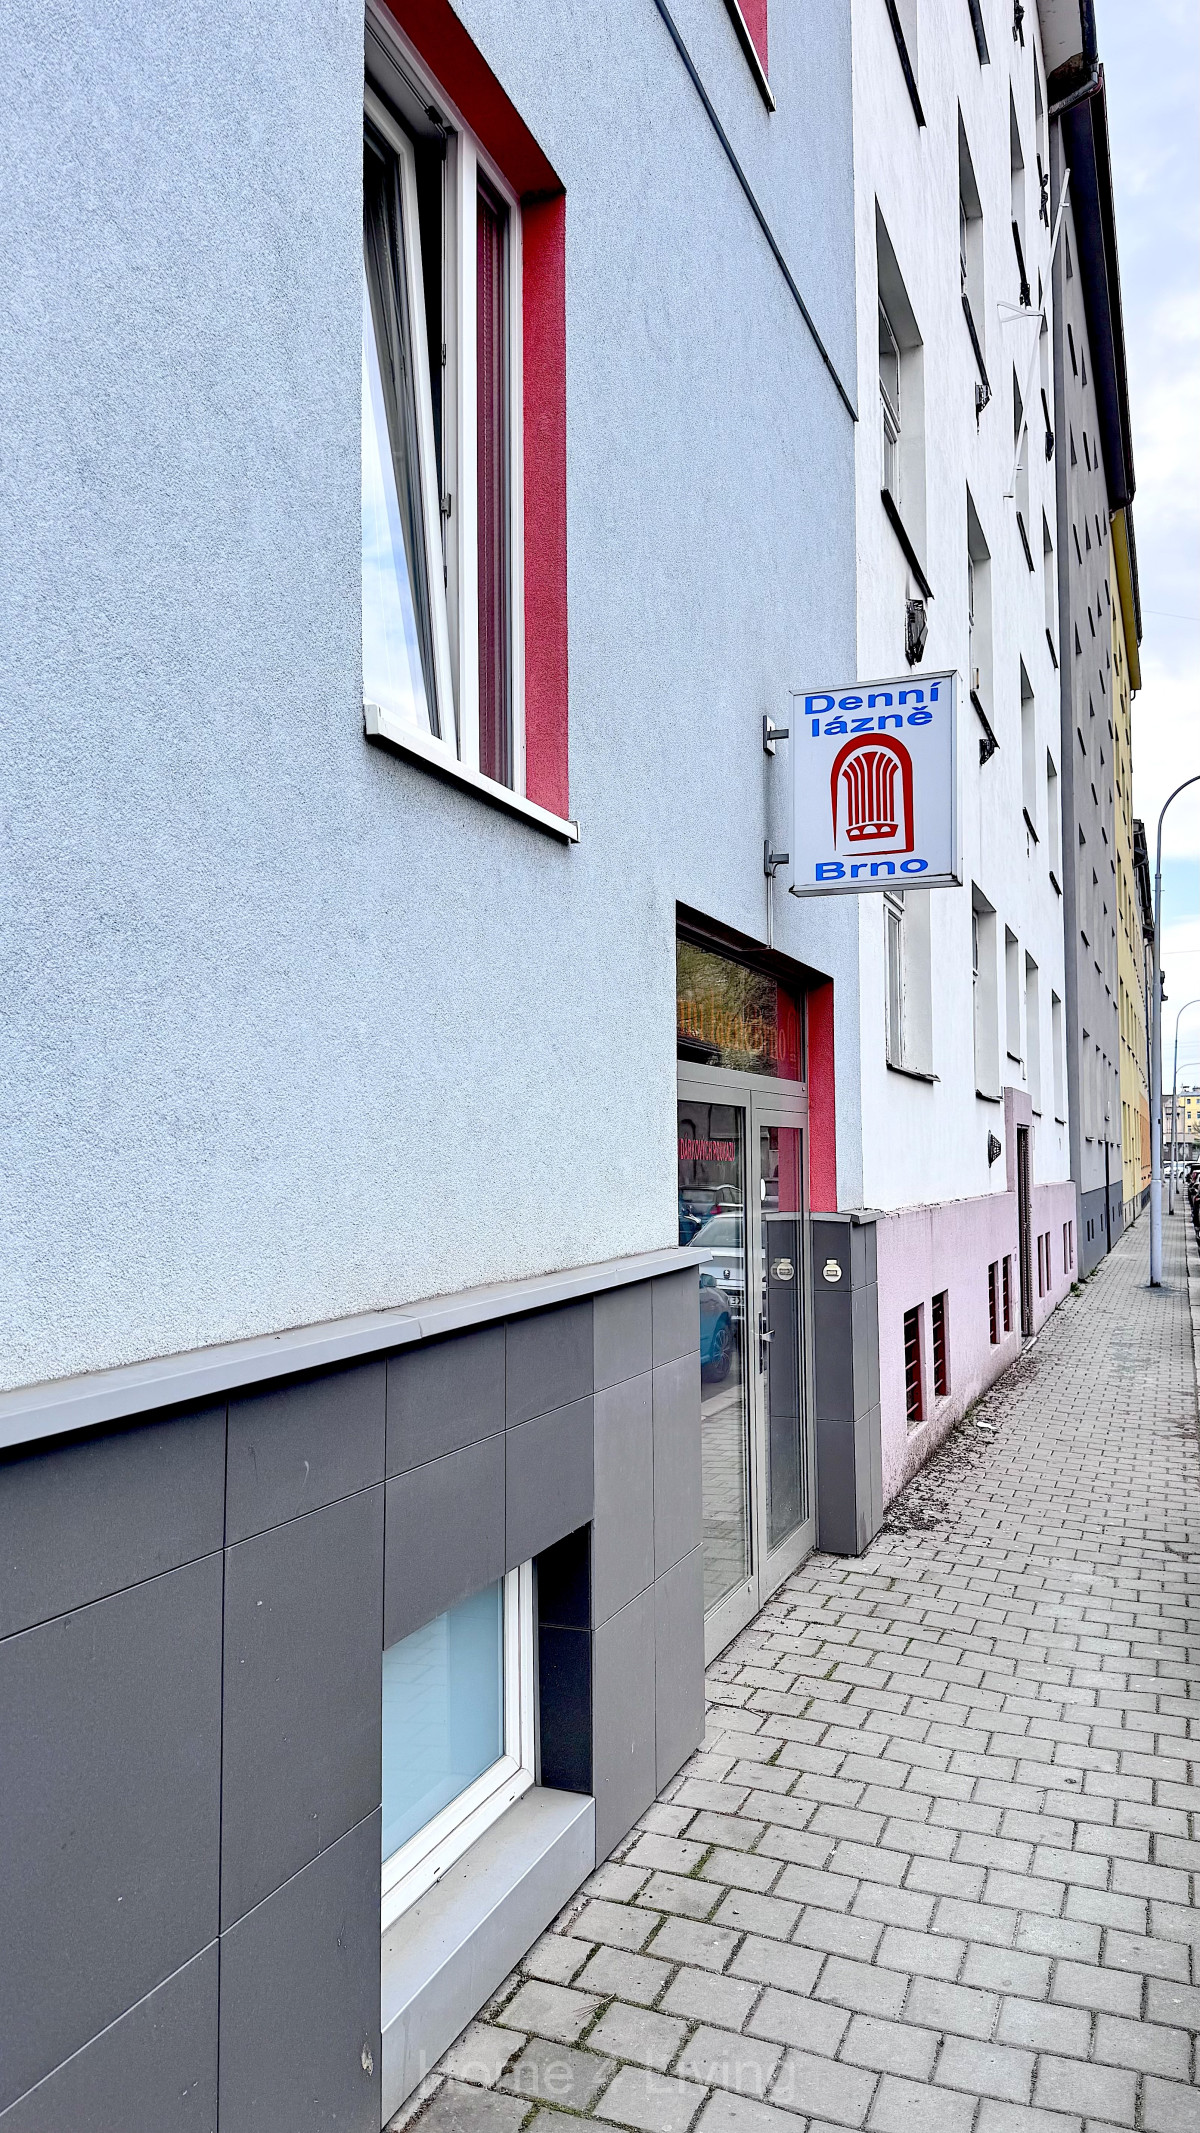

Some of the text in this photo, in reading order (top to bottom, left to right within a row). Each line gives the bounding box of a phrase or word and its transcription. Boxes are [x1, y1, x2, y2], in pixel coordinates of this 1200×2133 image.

[805, 681, 942, 715] Denní
[811, 706, 933, 738] lázně
[815, 859, 929, 882] Brno
